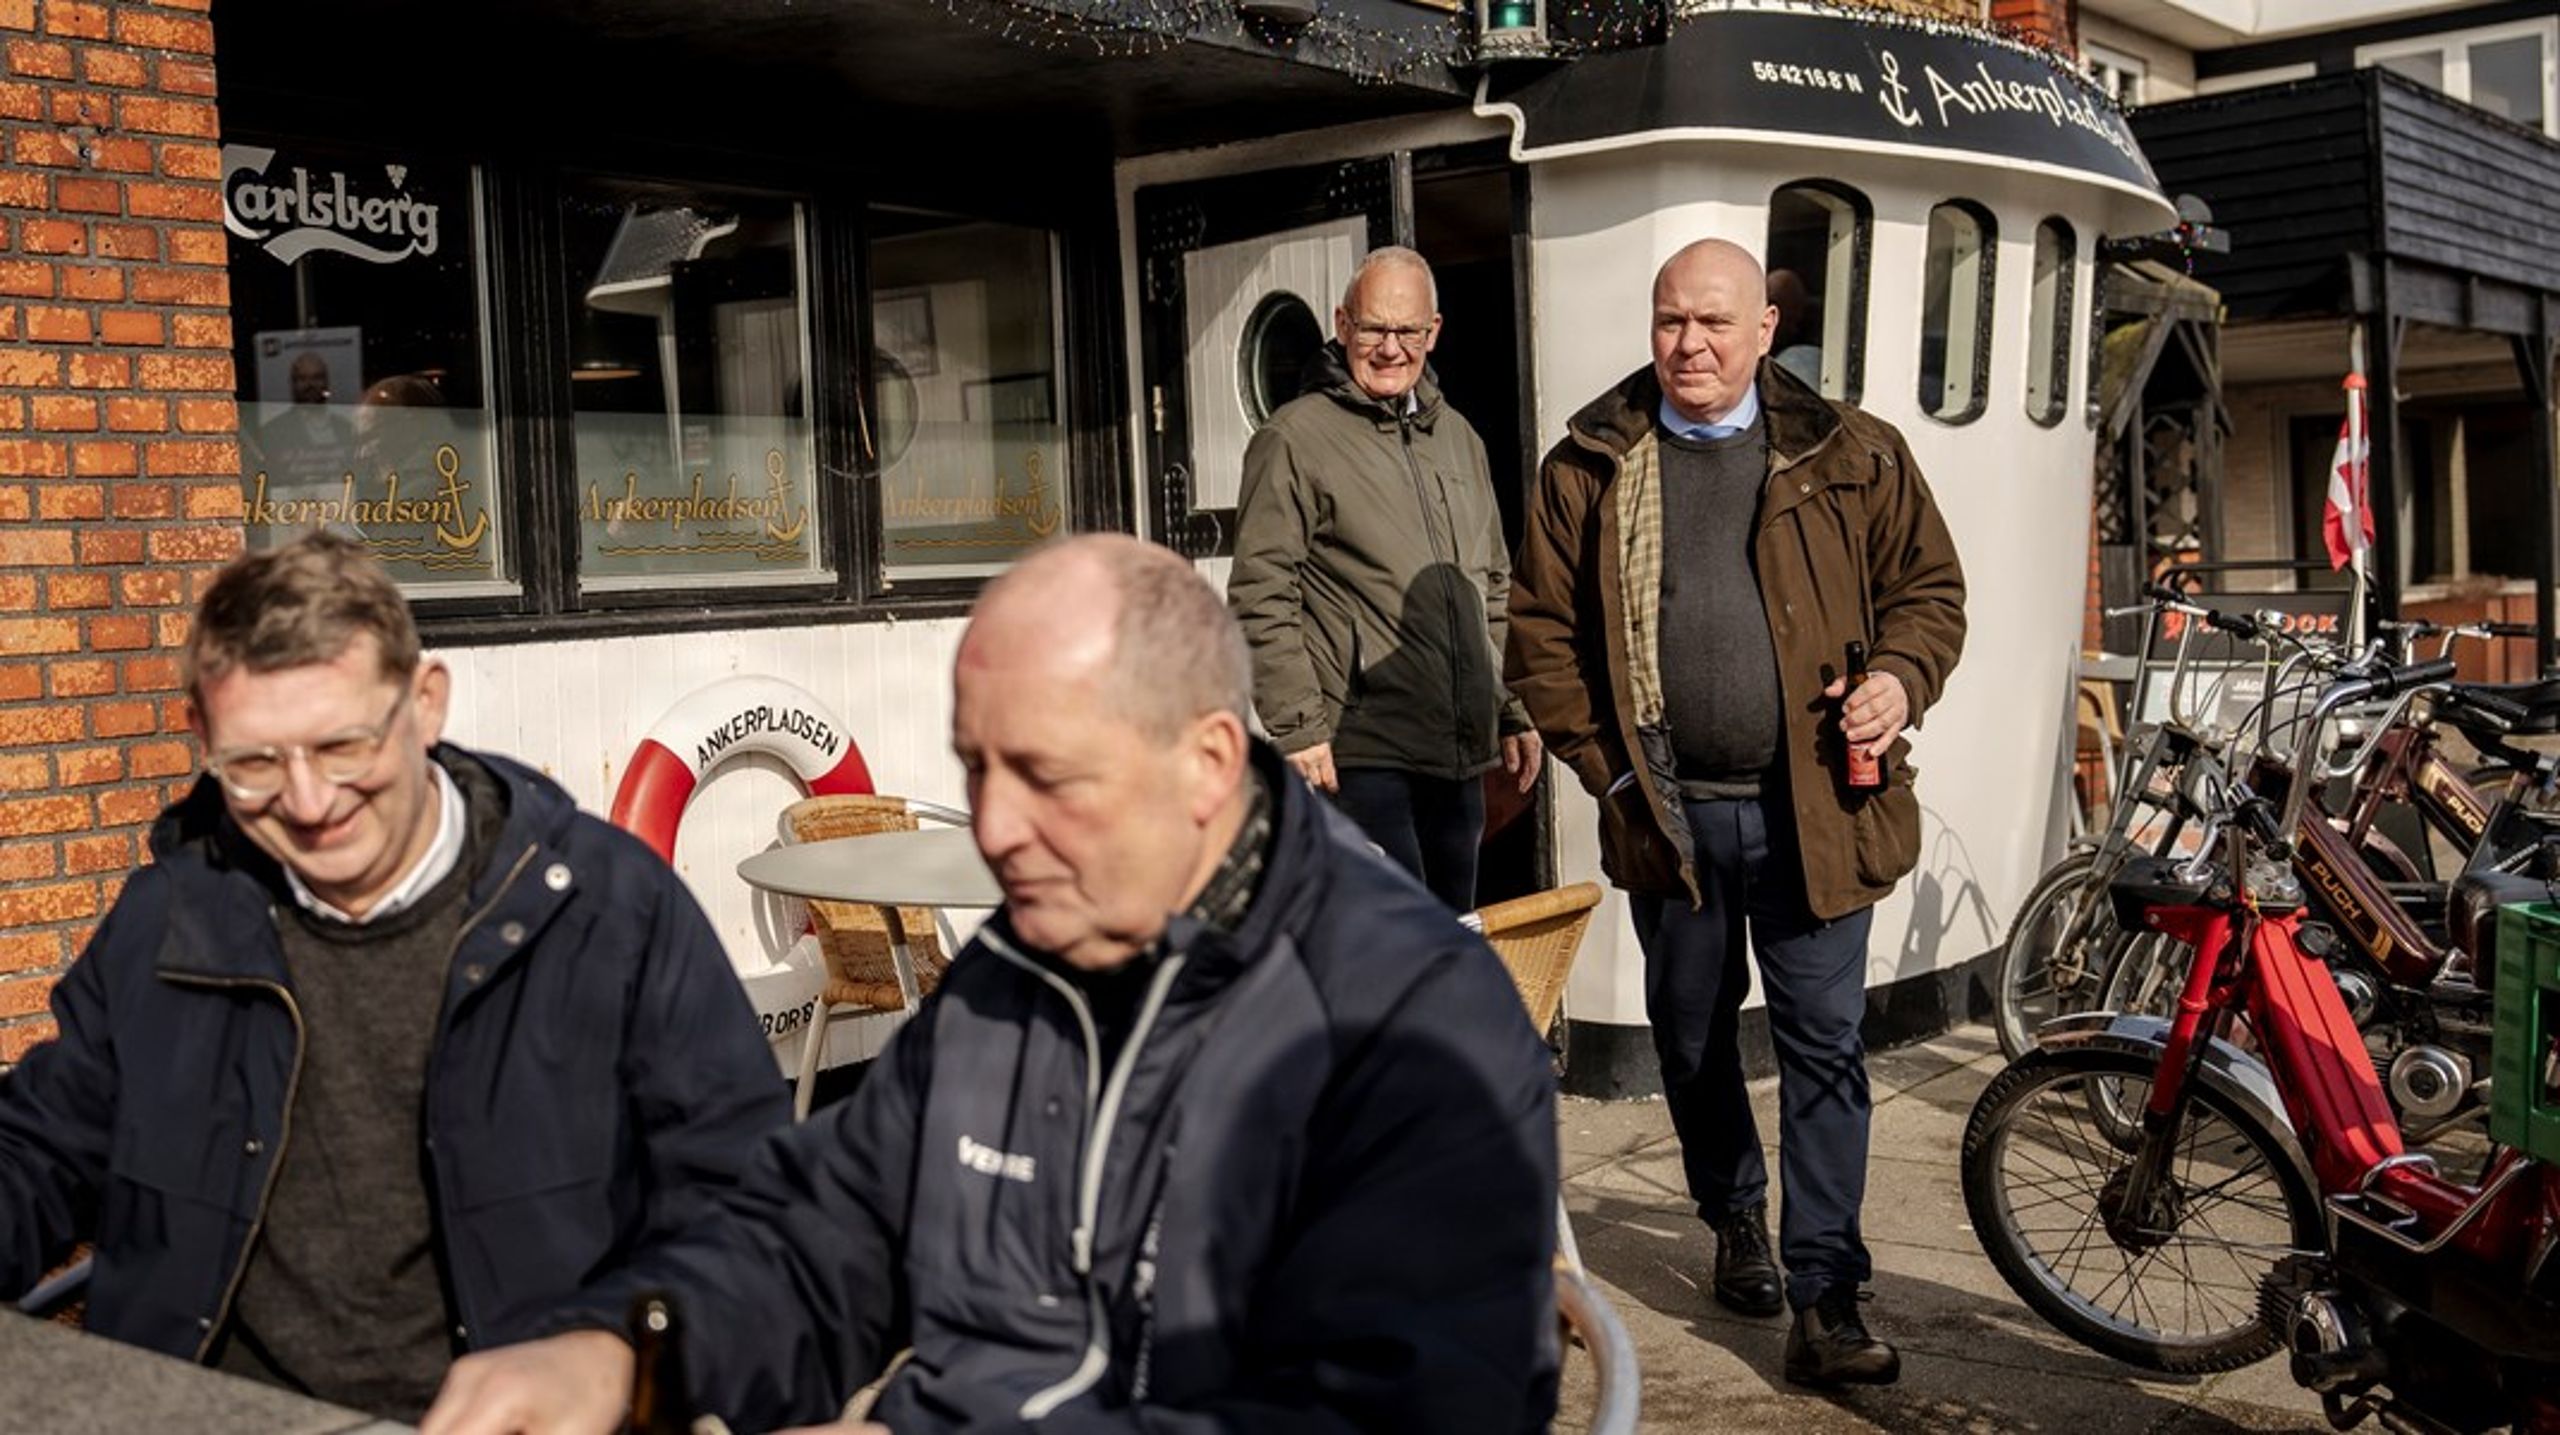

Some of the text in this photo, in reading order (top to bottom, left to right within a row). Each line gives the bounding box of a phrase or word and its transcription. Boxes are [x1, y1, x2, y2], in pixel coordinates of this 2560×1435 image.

[1844, 71, 1863, 93] N
[222, 143, 439, 264] Carlsberg
[579, 472, 780, 531] Ankerpladsen
[697, 705, 837, 769] ANKERPLADSEN
[2447, 796, 2484, 834] PUC
[2310, 862, 2362, 920] PUCH
